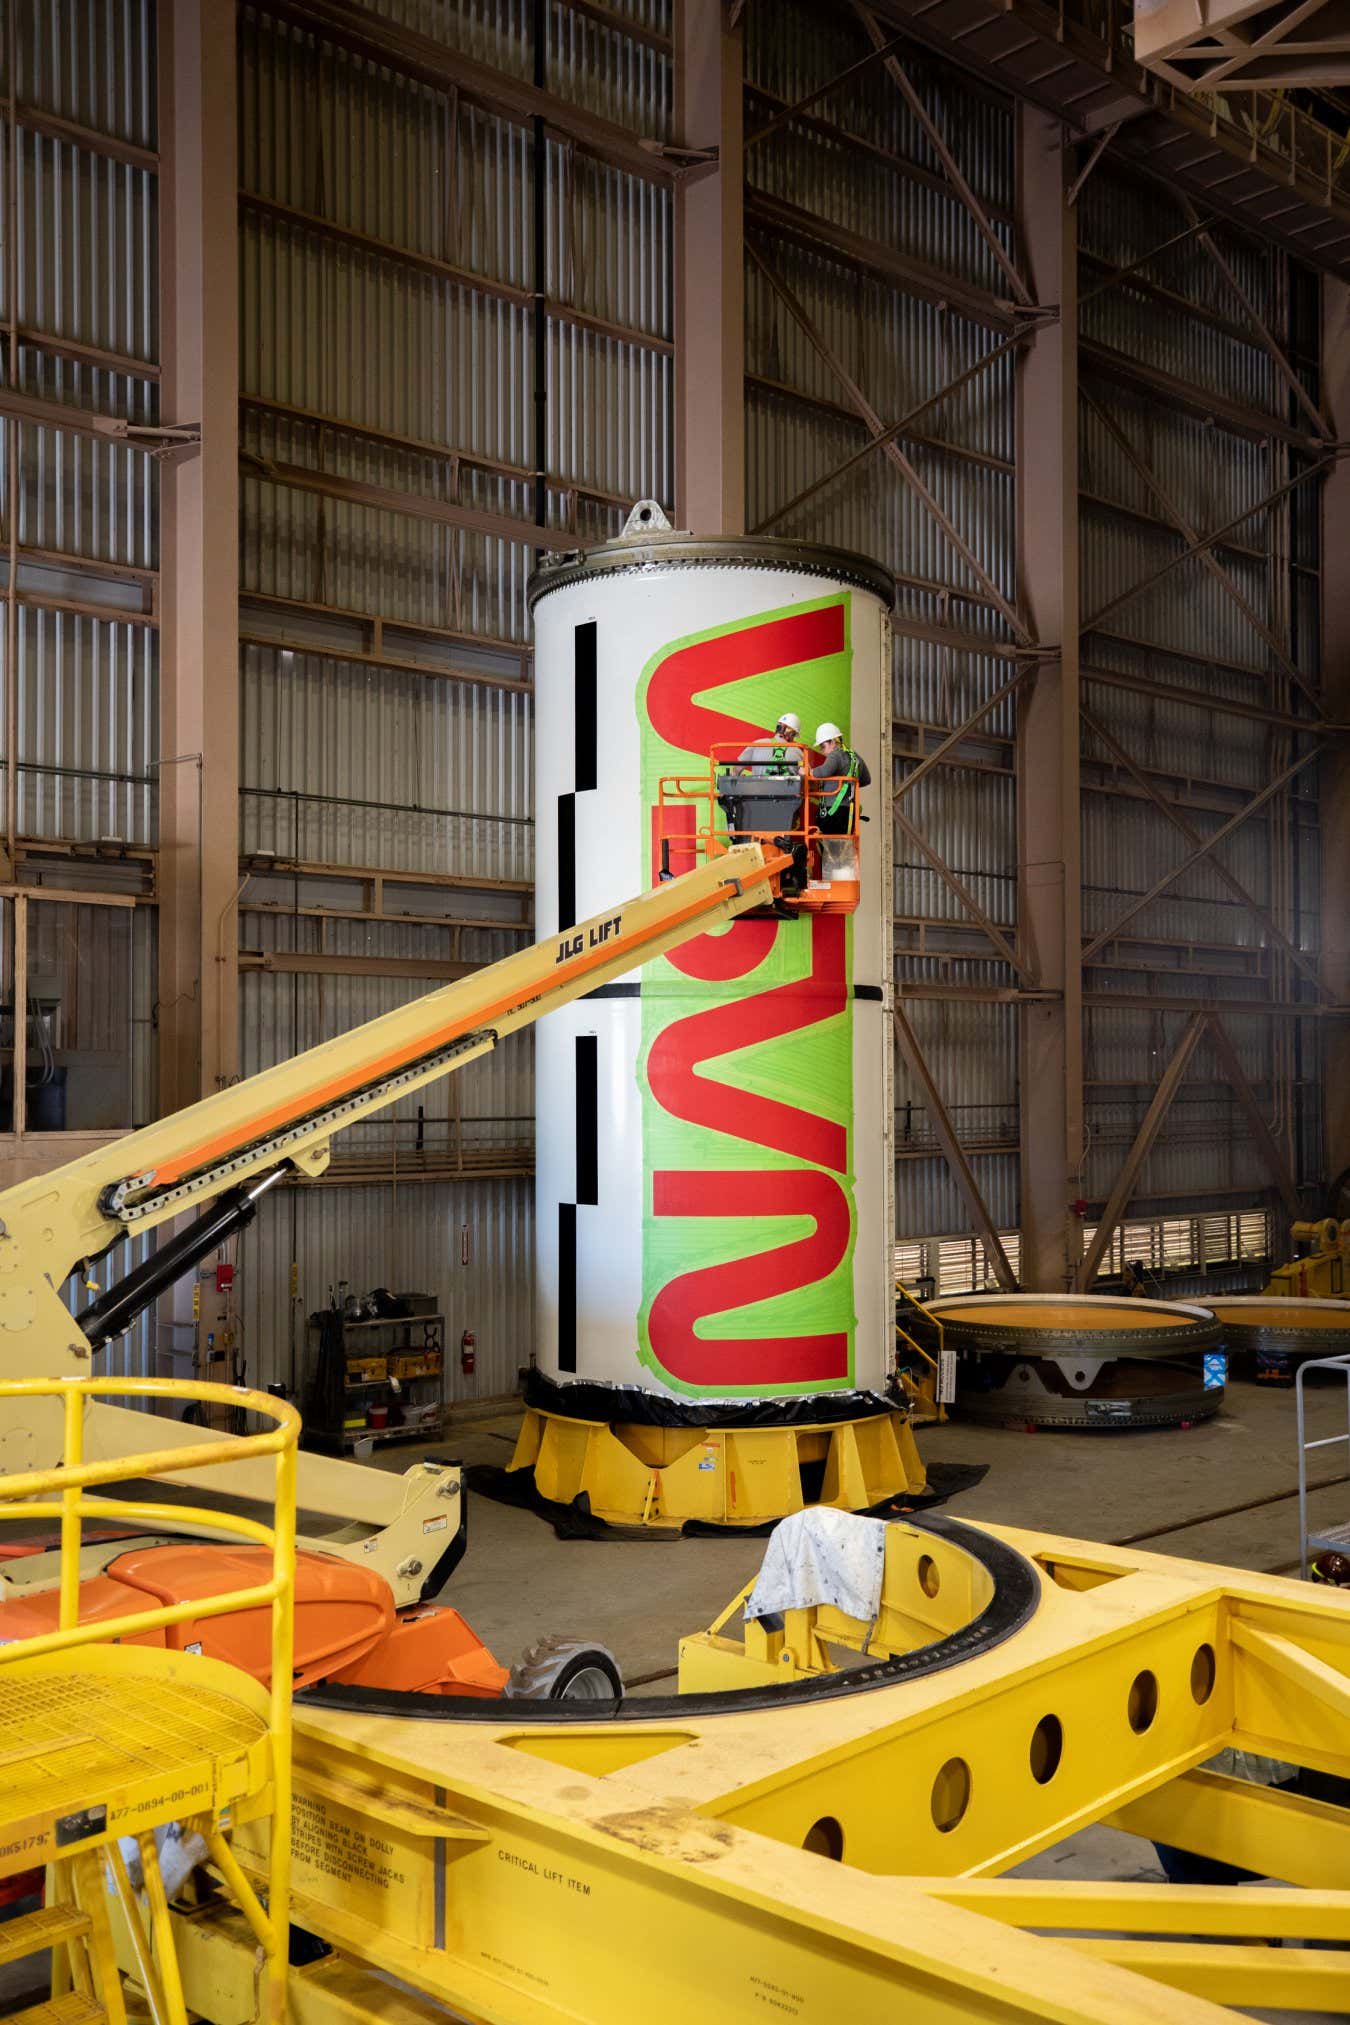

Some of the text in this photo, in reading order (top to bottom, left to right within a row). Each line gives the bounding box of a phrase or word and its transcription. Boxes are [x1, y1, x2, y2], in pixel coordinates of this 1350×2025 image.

[555, 915, 622, 965] JLG LIFT
[647, 603, 851, 1387] NASA
[290, 1836, 321, 1857] BEFORE
[291, 1803, 394, 1855] POSITION BEAM ON DOLLY
[291, 1815, 368, 1856] BY ALIGNING BLACK
[290, 1848, 311, 1864] FROM
[314, 1858, 352, 1884] SEGMENT
[291, 1825, 405, 1884] STRIPES WITH SCREW JACKS
[498, 1849, 591, 1896] CRITICAL LIFT ITEM
